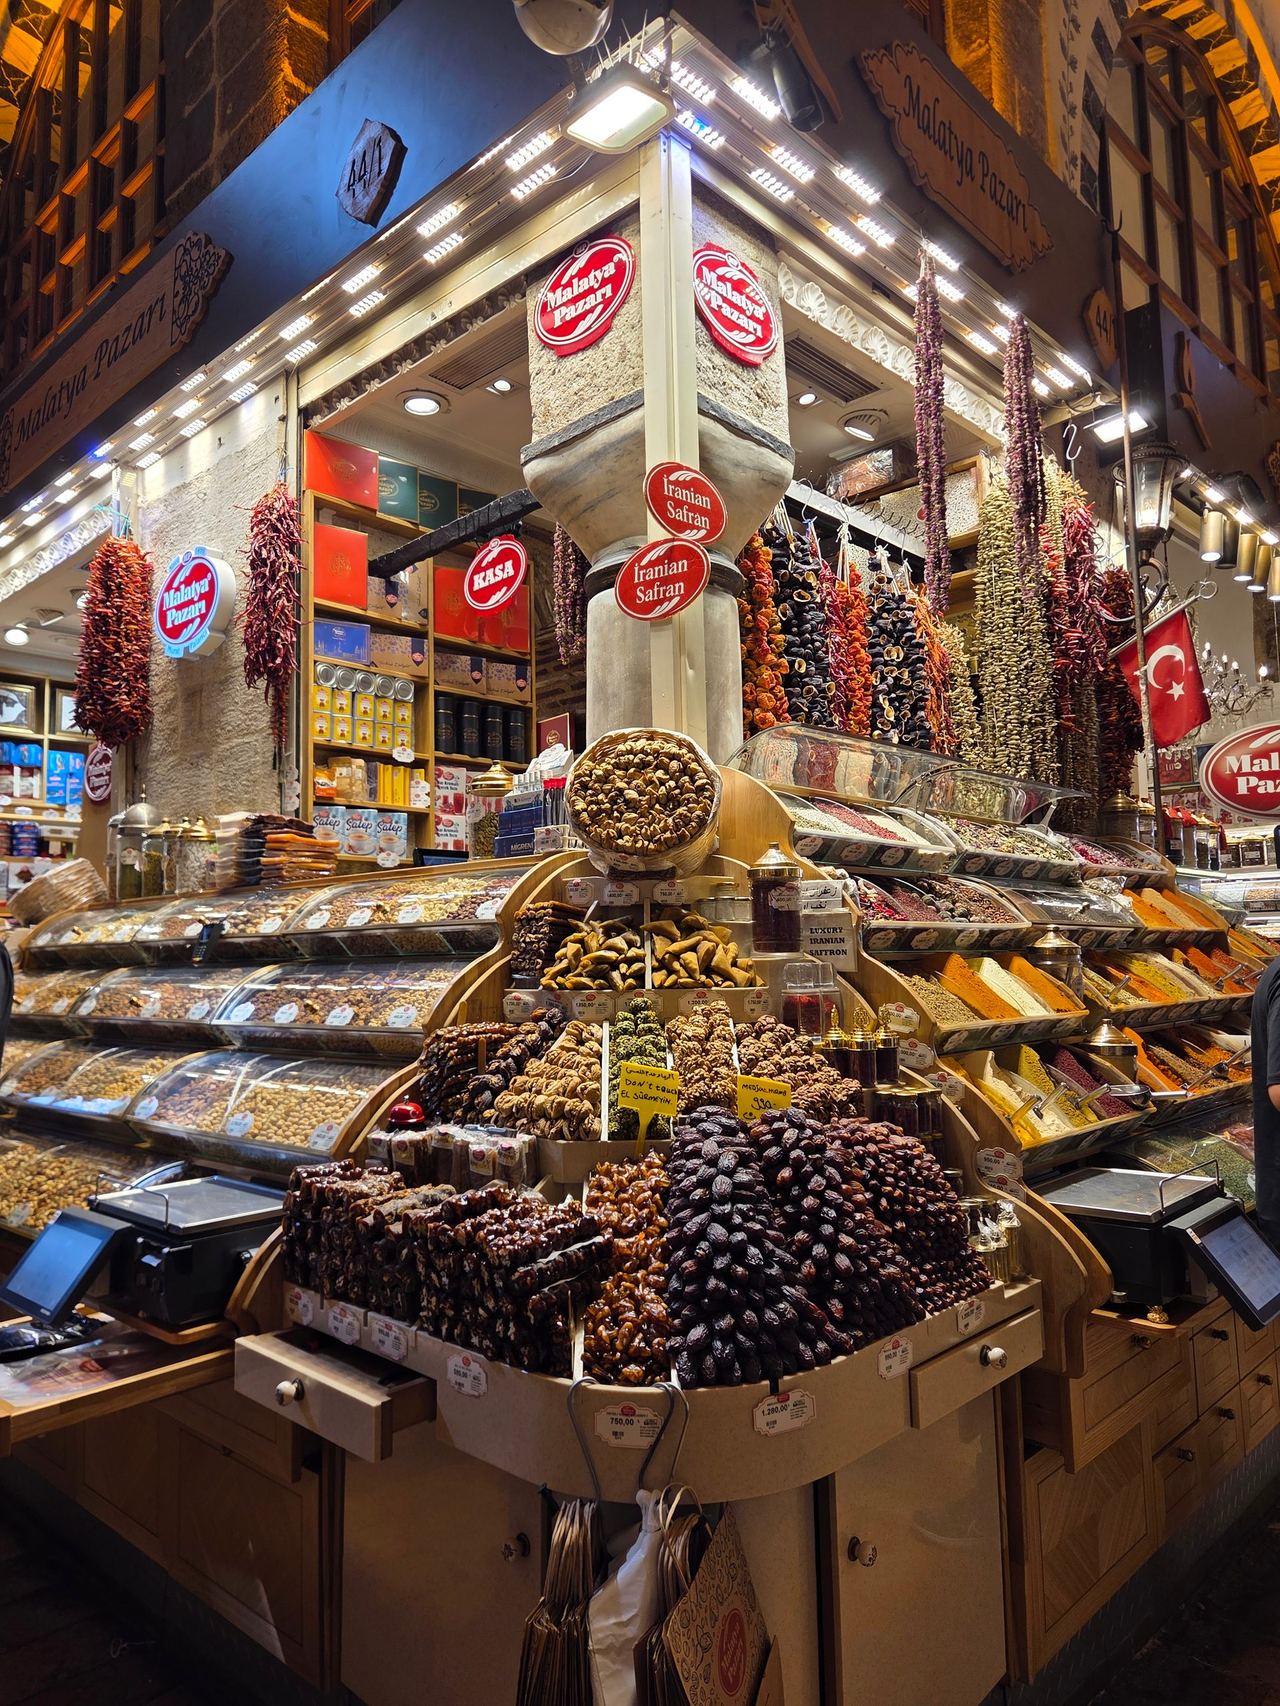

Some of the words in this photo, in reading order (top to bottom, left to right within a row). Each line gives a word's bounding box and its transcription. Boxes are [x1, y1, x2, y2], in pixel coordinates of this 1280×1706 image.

[347, 135, 383, 199] 44/1
[903, 75, 975, 187] Malatya
[978, 151, 1028, 233] Pazarı
[544, 261, 616, 312] Malatya
[701, 265, 765, 321] Malatya
[553, 283, 613, 328] Pazarı
[708, 289, 763, 338] Pazarı
[14, 365, 88, 451] Malatya
[93, 293, 167, 380] Pazarı
[663, 474, 711, 509] İranian
[667, 501, 710, 529] Safran
[473, 560, 514, 591] KASA
[634, 559, 688, 584] İranian
[162, 578, 209, 610] Malatya
[636, 581, 685, 604] Safran
[166, 600, 206, 629] Pazarı
[313, 815, 340, 830] Salep
[346, 818, 373, 832] Salep
[377, 820, 403, 835] Salep
[809, 927, 843, 935] LUXURY
[809, 937, 845, 945] IRANIAN
[621, 1089, 630, 1098] EL
[610, 1417, 634, 1426] 750,00
[762, 1404, 788, 1416] 1.280,00
